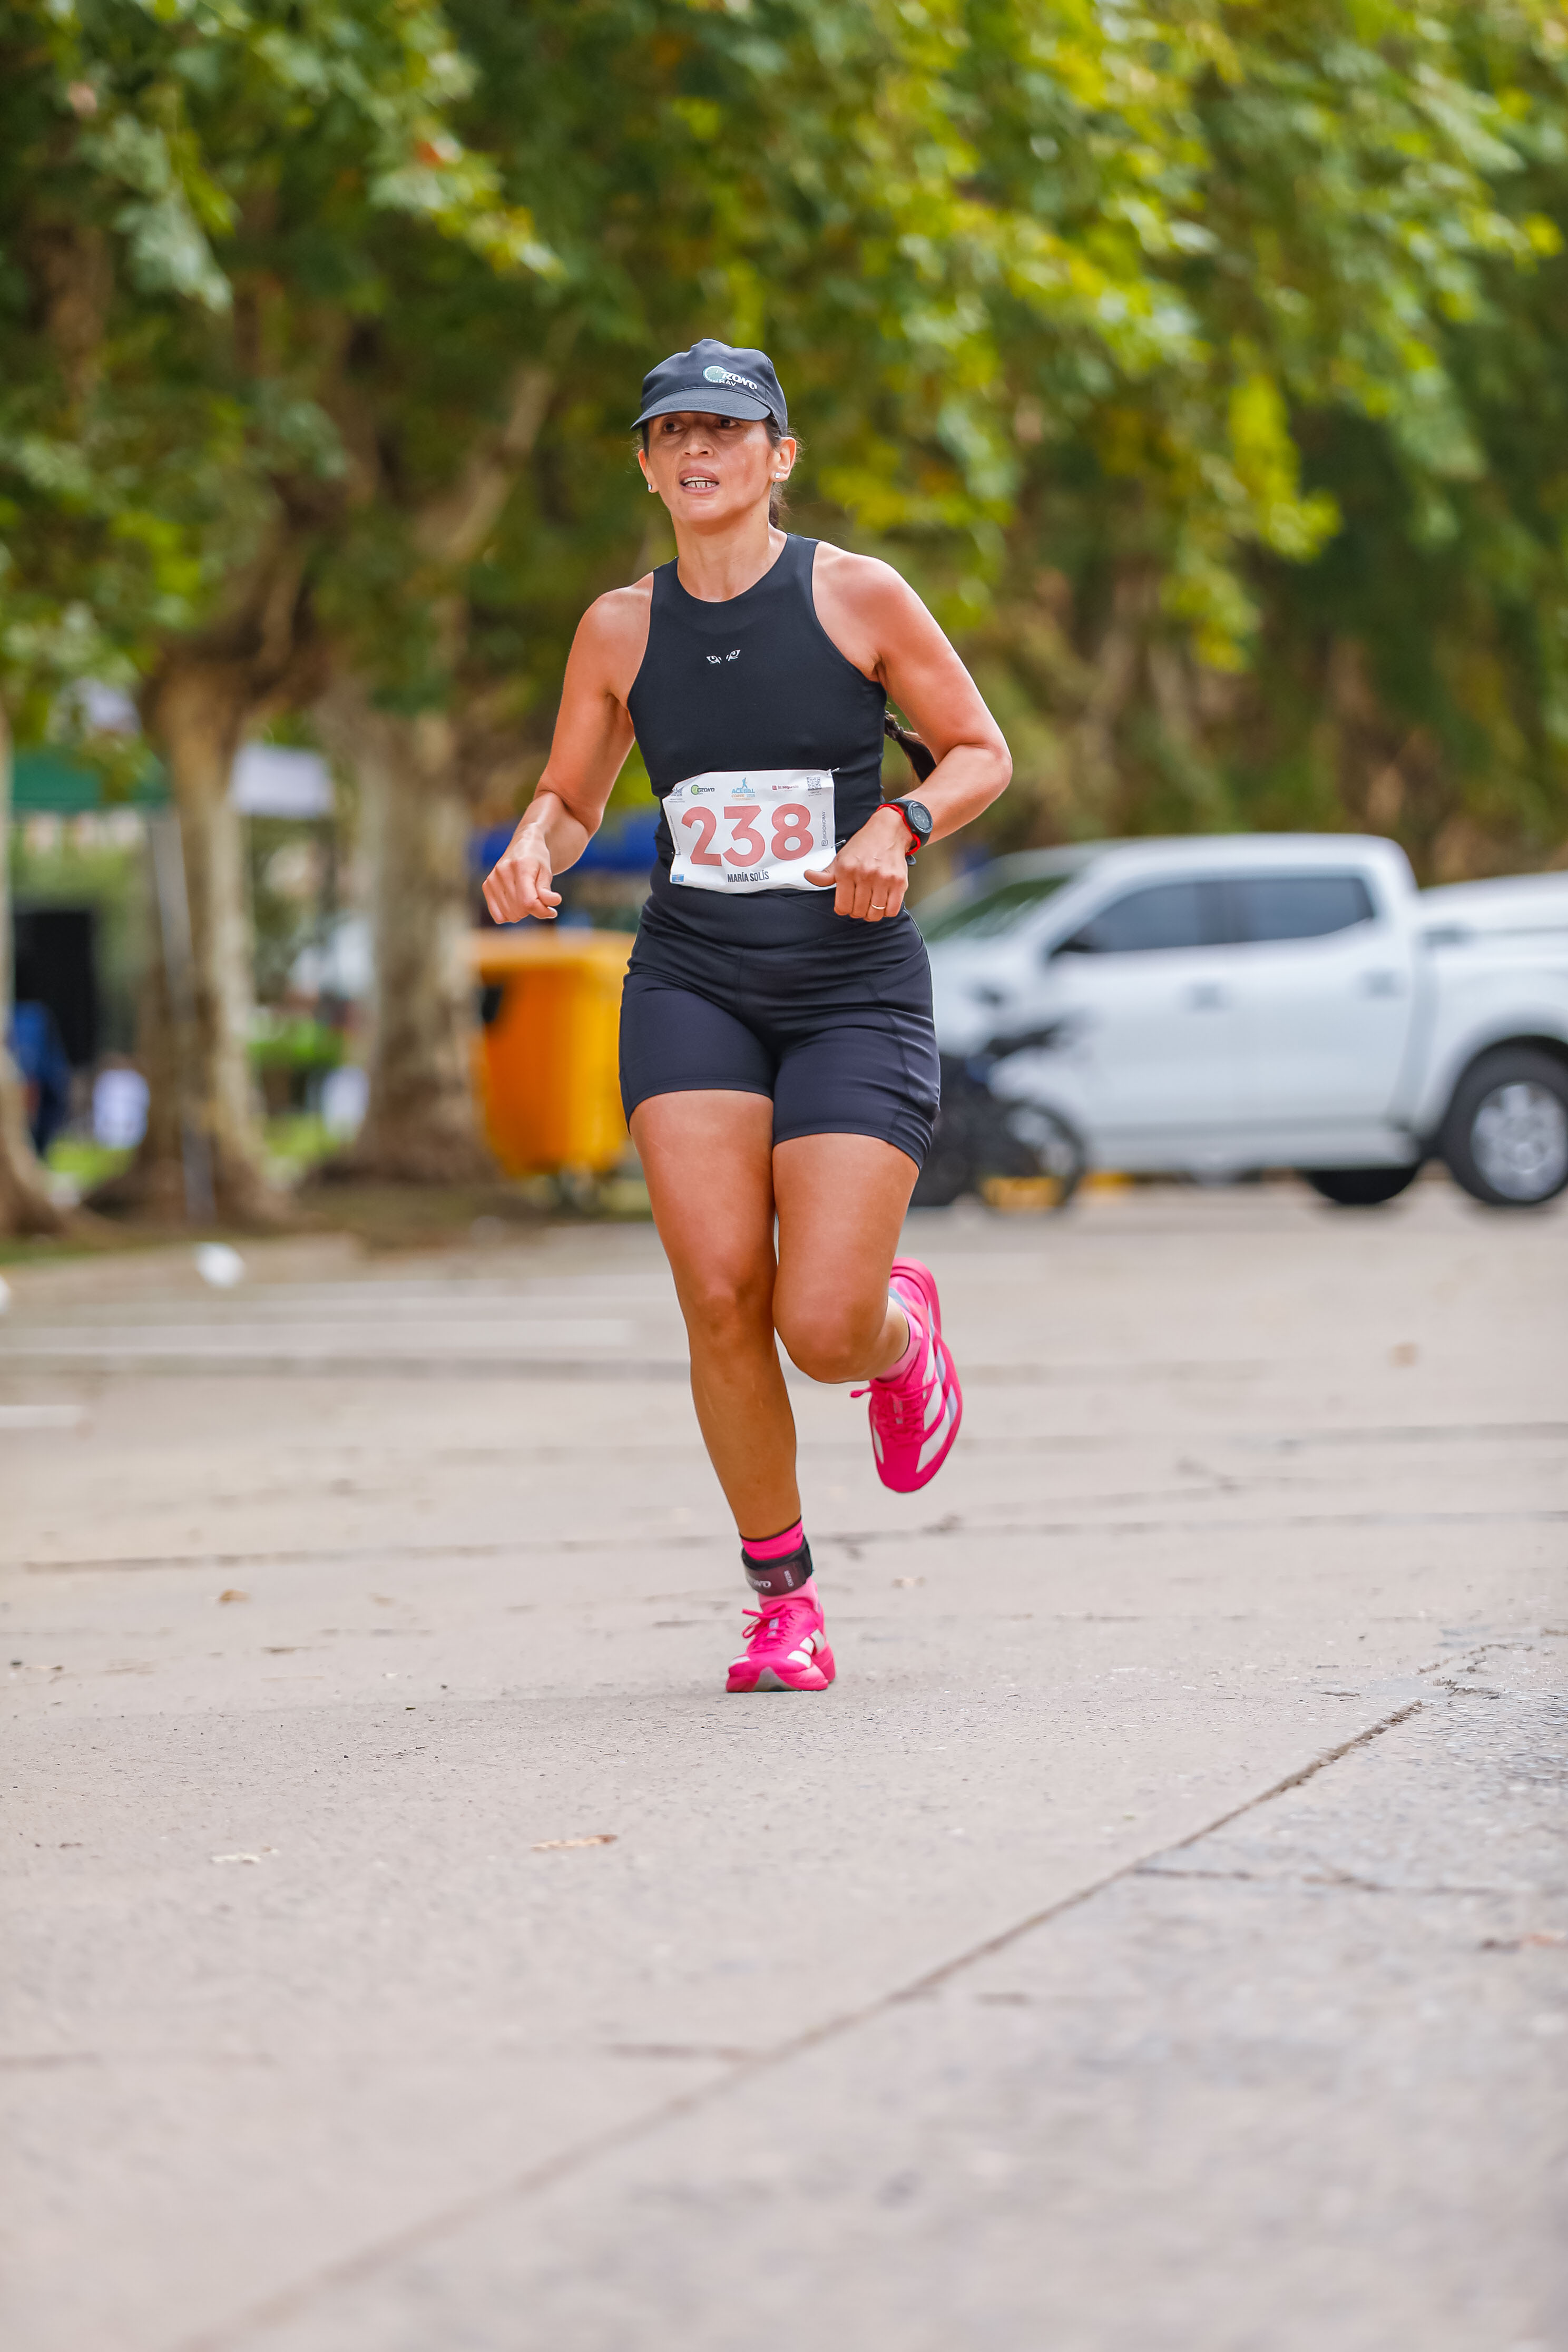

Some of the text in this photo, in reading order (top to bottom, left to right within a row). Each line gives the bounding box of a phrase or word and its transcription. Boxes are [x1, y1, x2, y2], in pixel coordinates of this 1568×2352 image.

[681, 803, 814, 867] 238
[727, 870, 769, 883] MARÍA SOLÍS
